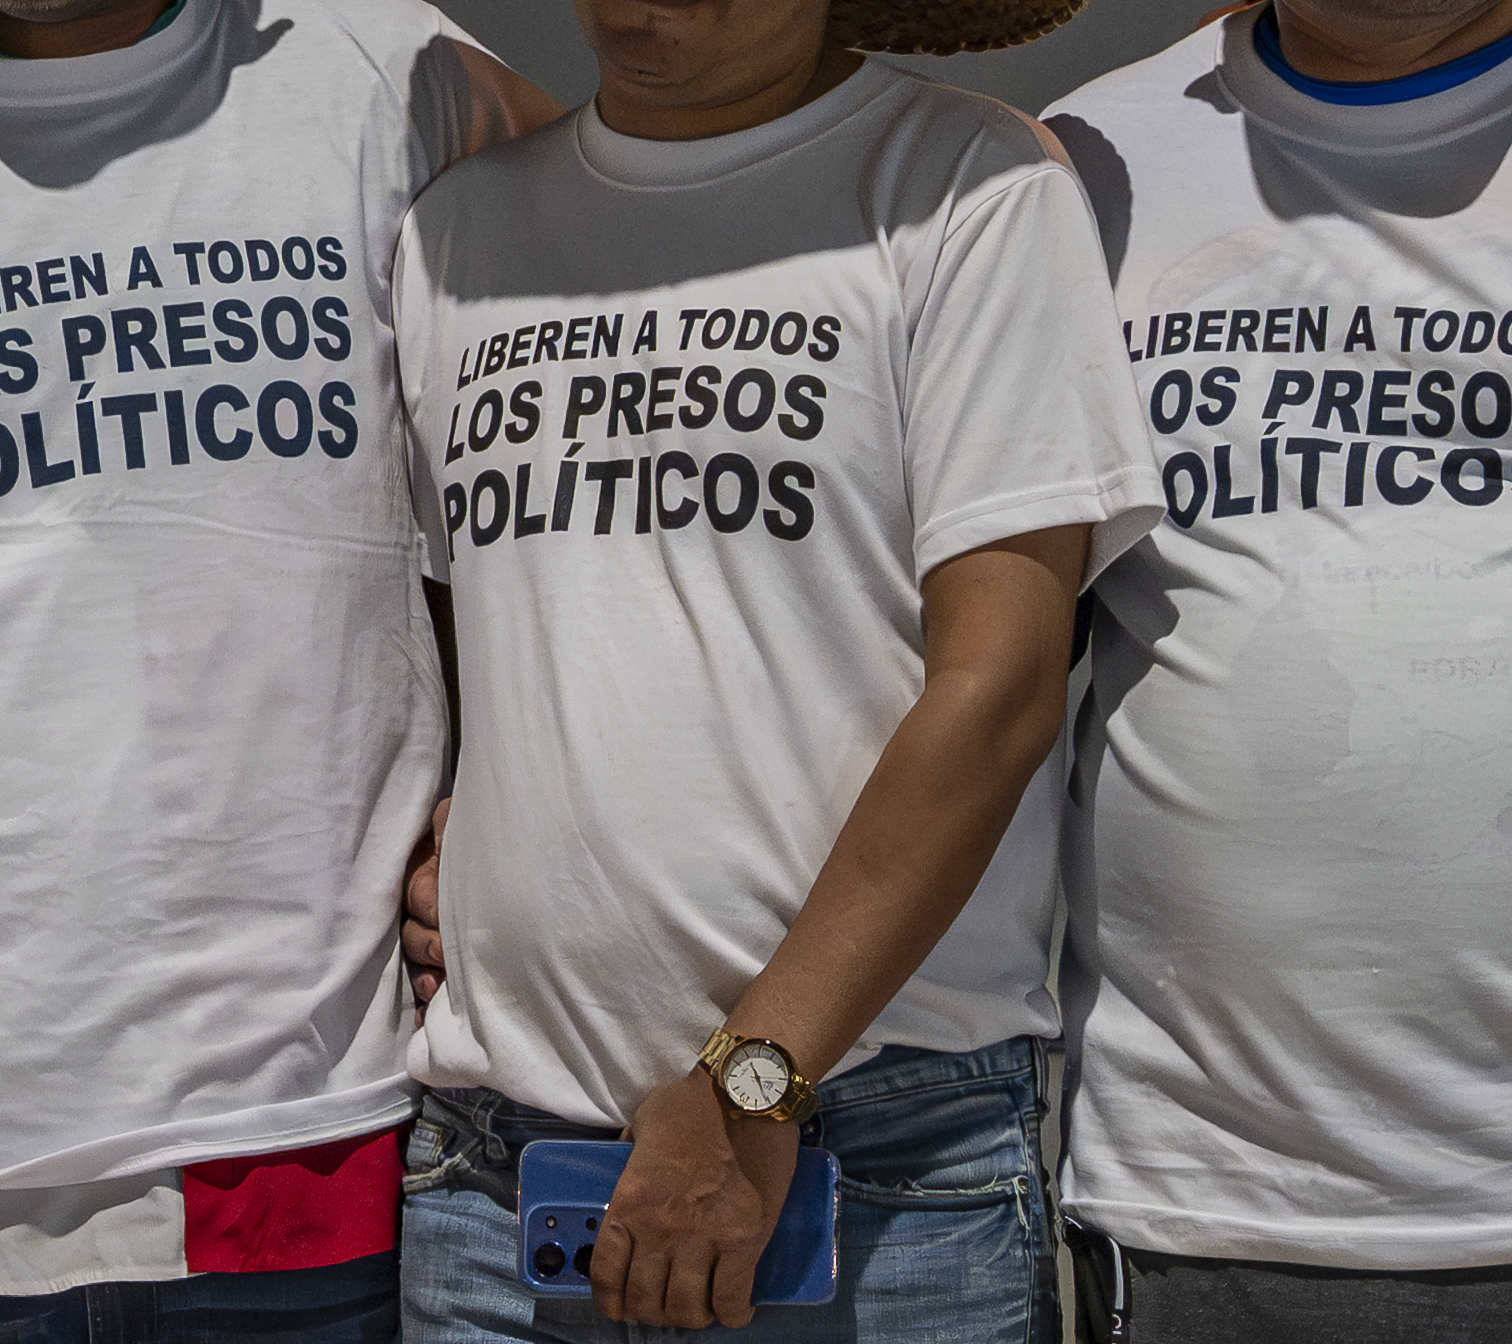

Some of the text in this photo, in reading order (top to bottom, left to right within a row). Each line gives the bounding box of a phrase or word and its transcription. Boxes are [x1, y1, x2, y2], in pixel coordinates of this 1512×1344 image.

[126, 246, 164, 291] A
[174, 236, 348, 286] TODOS
[61, 295, 352, 383] PRESOS
[456, 308, 842, 392] LIBEREN A TODOS
[1123, 305, 1328, 364] LIBEREN
[1343, 305, 1377, 353] A
[445, 364, 828, 466] LOS PRESOS
[1149, 366, 1242, 436] OS
[444, 442, 816, 564] POLÍTICOS
